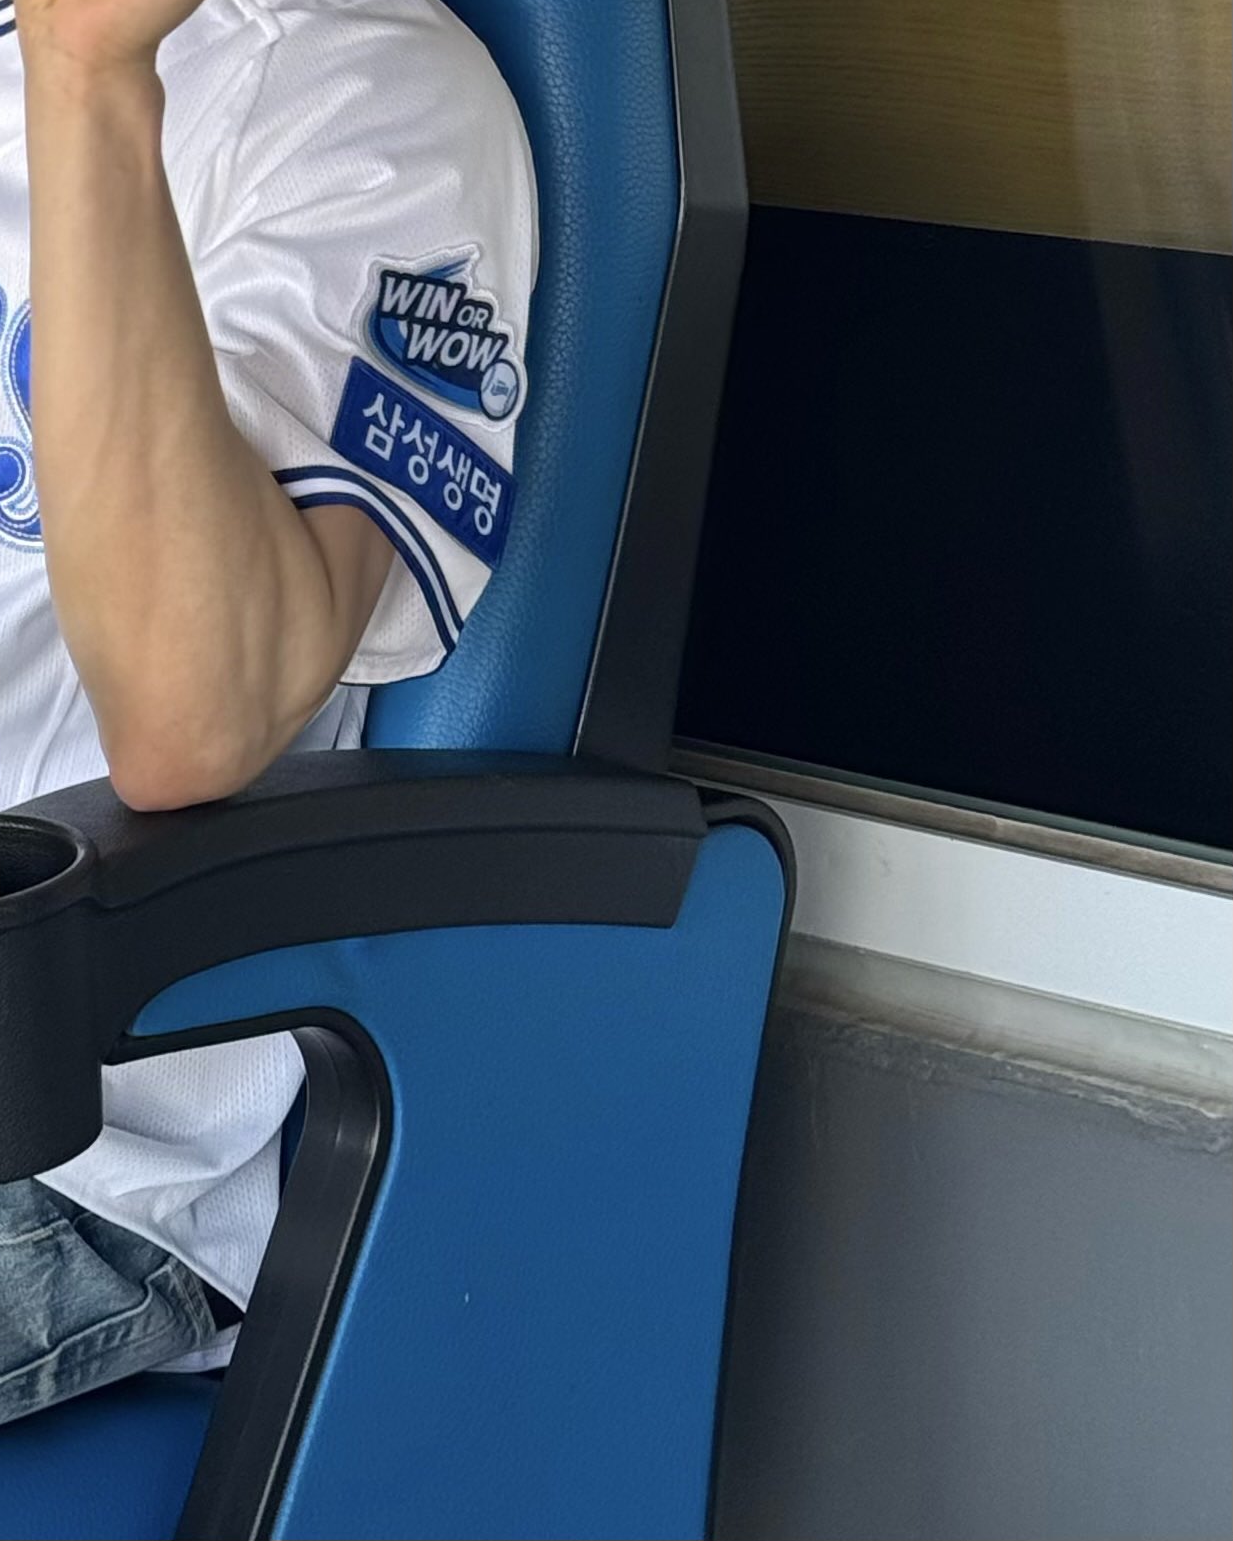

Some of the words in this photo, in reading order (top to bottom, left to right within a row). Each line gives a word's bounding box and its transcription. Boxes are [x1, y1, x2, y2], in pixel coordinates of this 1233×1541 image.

[383, 277, 461, 322] WIN
[457, 304, 489, 329] OR
[408, 324, 504, 373] WOW
[362, 392, 502, 536] 삼성생명
